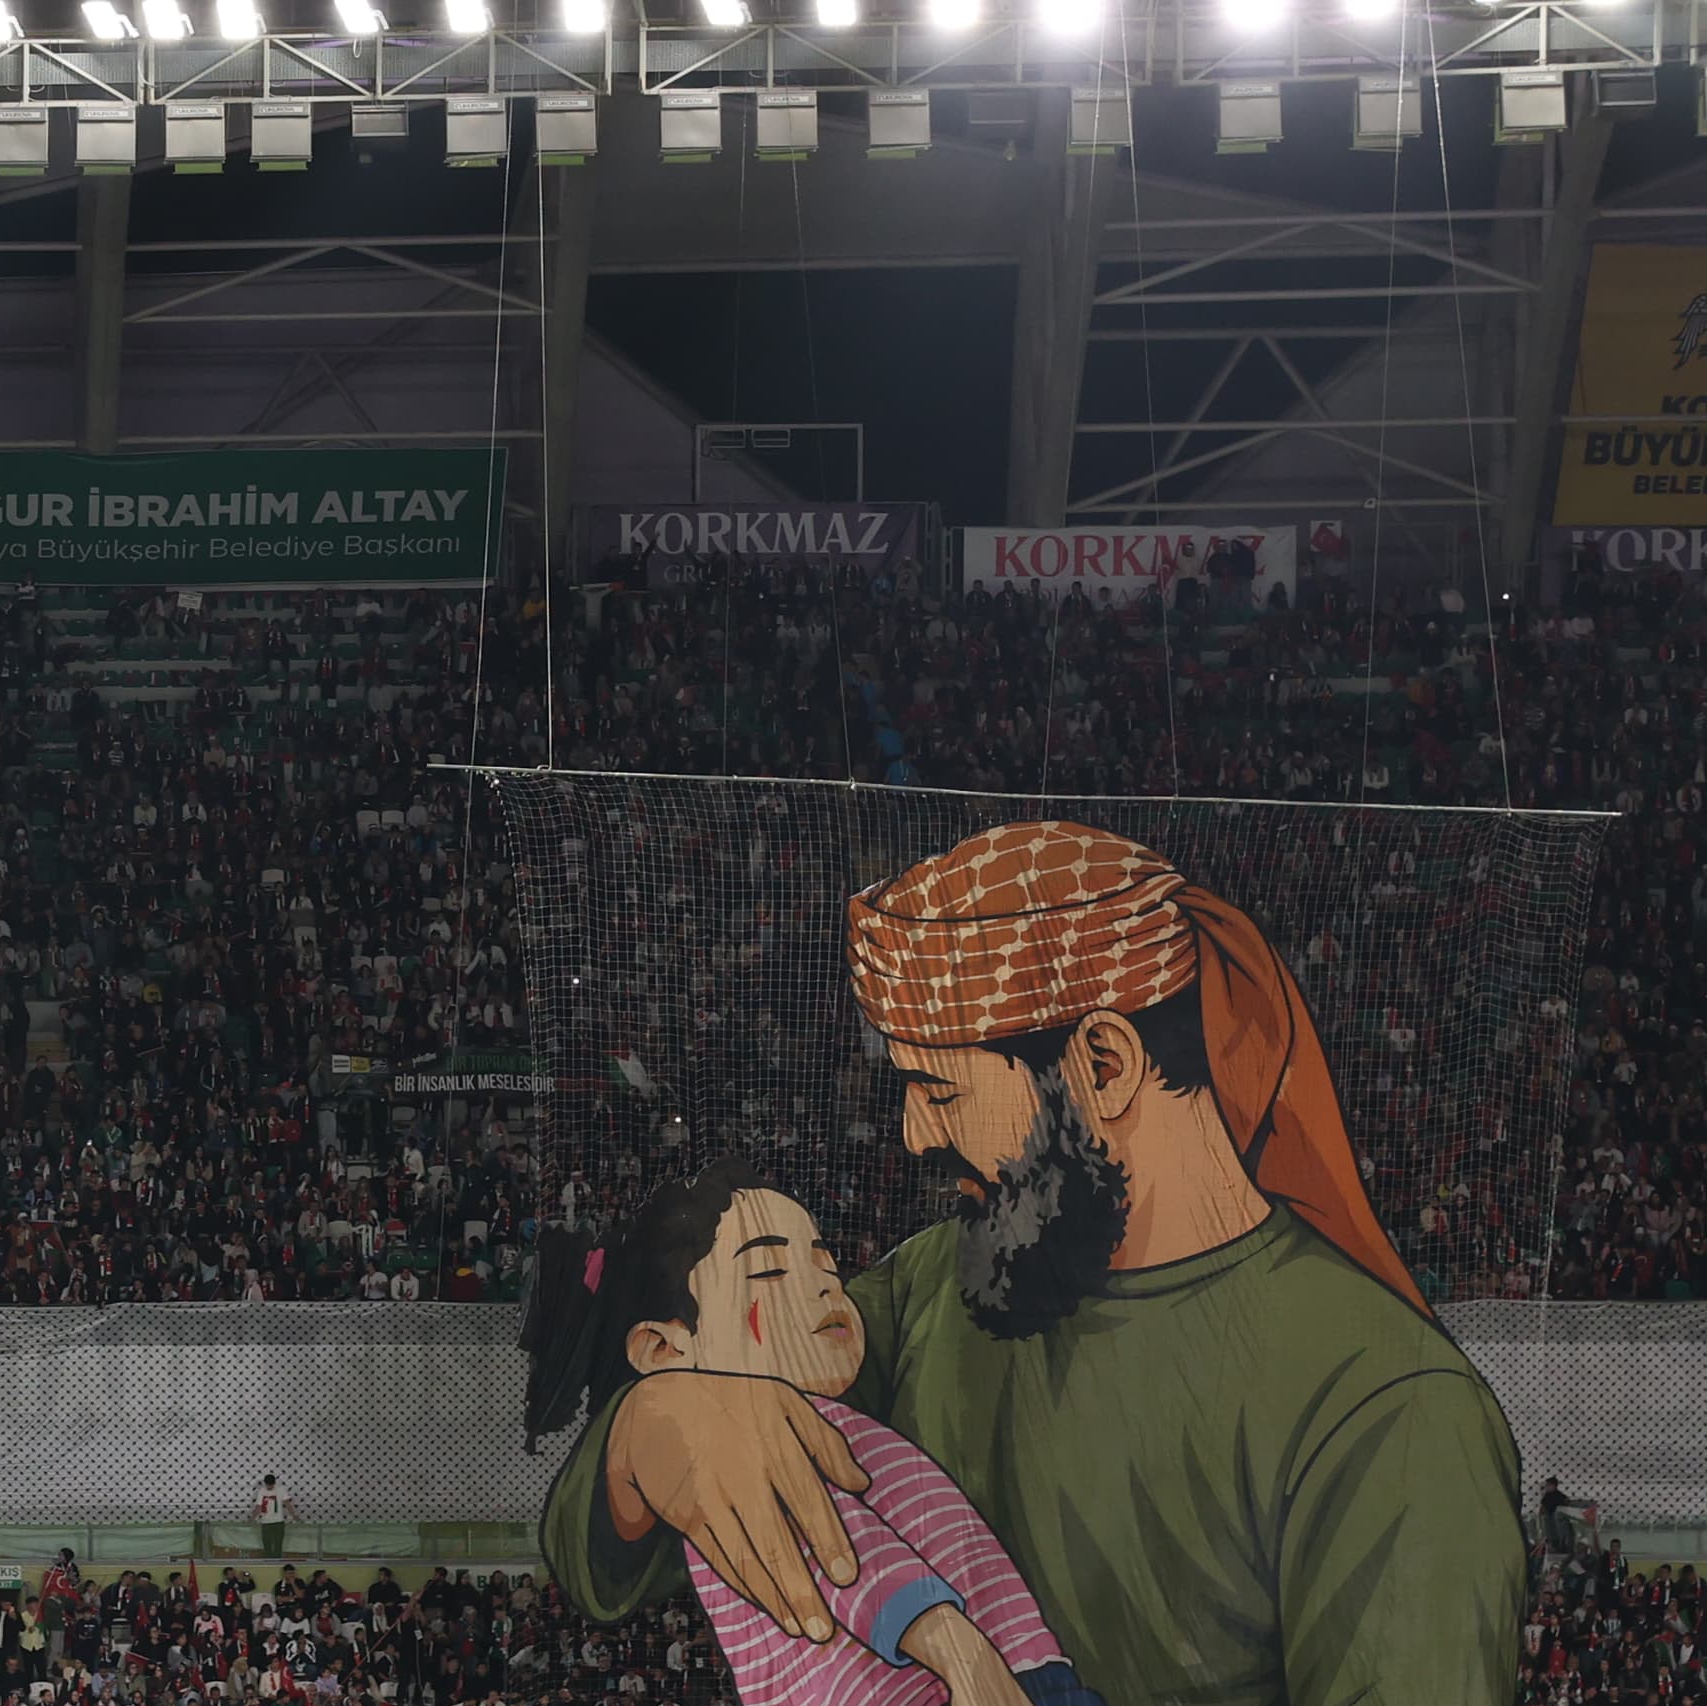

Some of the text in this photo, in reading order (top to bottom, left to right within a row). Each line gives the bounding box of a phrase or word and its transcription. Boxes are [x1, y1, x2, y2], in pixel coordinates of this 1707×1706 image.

[1584, 425, 1707, 467] BÜYÜ
[1634, 475, 1707, 494] BELE
[88, 482, 300, 527] İBRAHİM
[317, 487, 469, 525] ALTAY
[36, 533, 201, 564] Büyükşehir
[209, 531, 337, 561] Belediye
[344, 530, 461, 559] Başkanı
[618, 512, 890, 555] KORKMAZ
[418, 1072, 476, 1092] İNSANLIK
